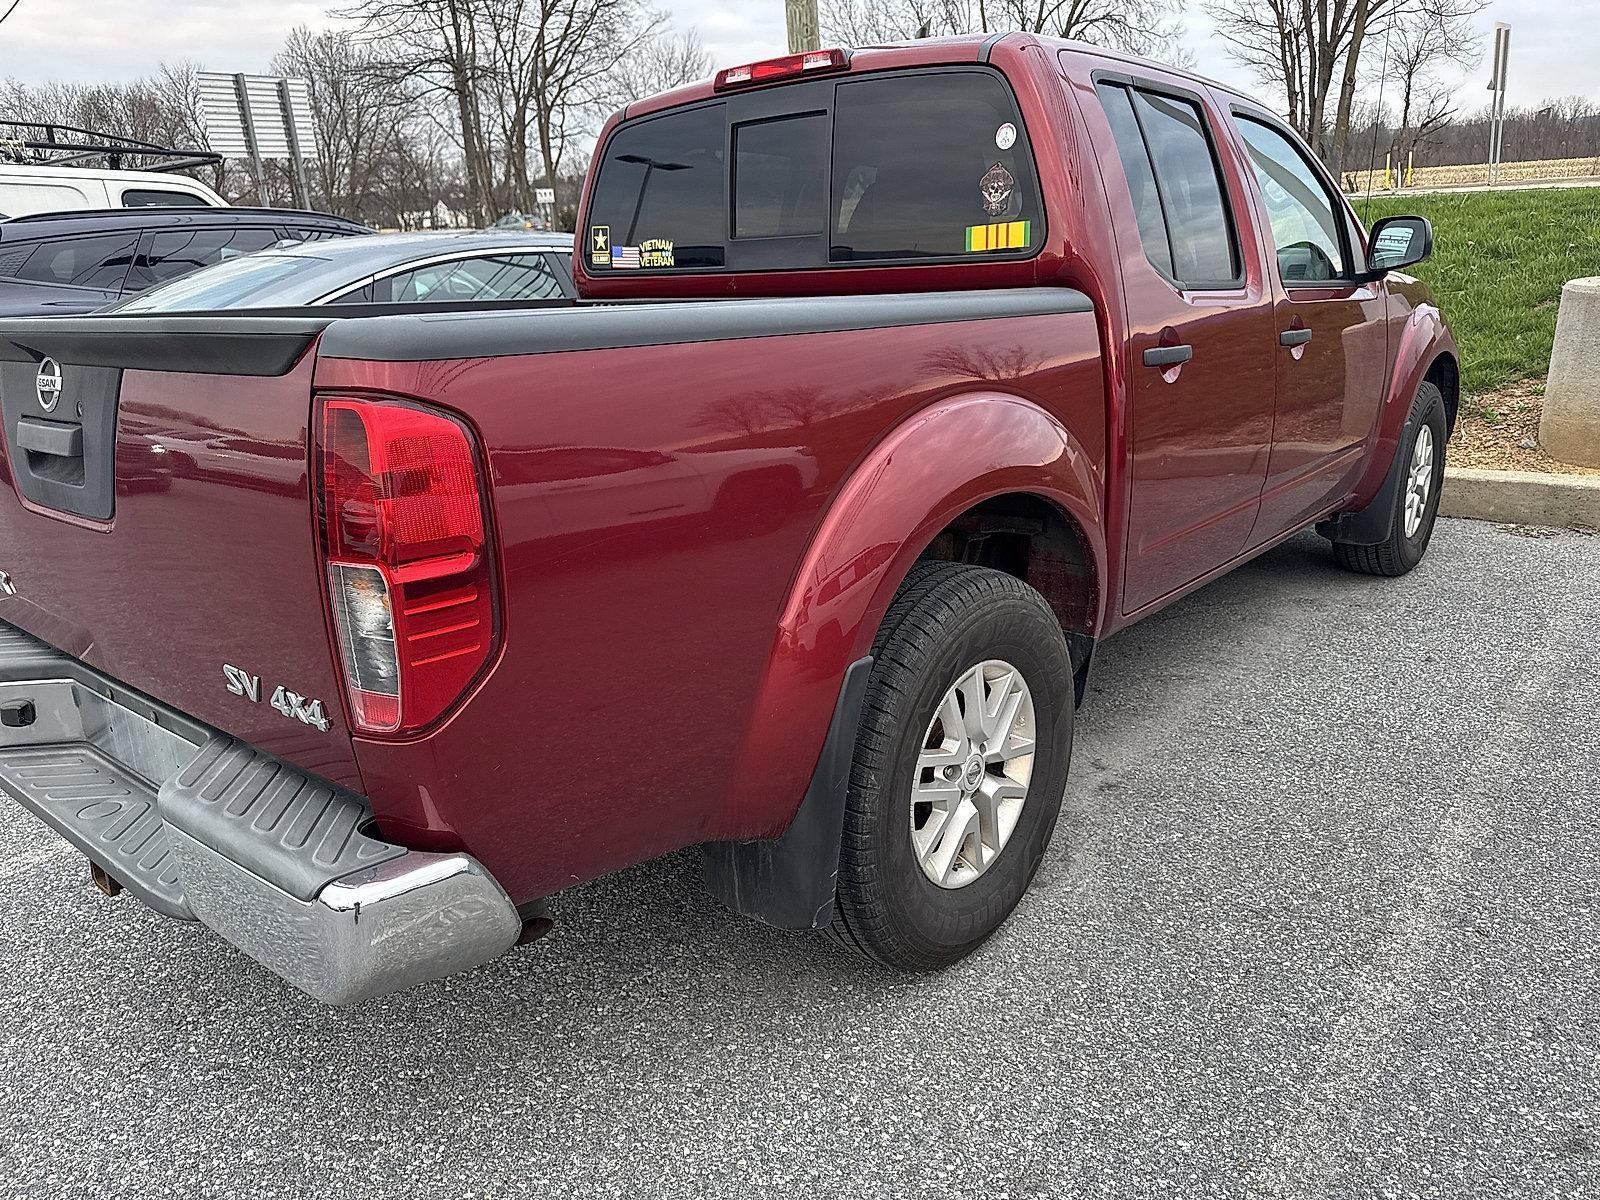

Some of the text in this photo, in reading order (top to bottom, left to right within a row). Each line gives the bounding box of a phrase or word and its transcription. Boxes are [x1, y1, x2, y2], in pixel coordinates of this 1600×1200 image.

[639, 239, 674, 252] VIETNAM
[640, 255, 675, 267] VETERAN
[222, 663, 261, 702] SV
